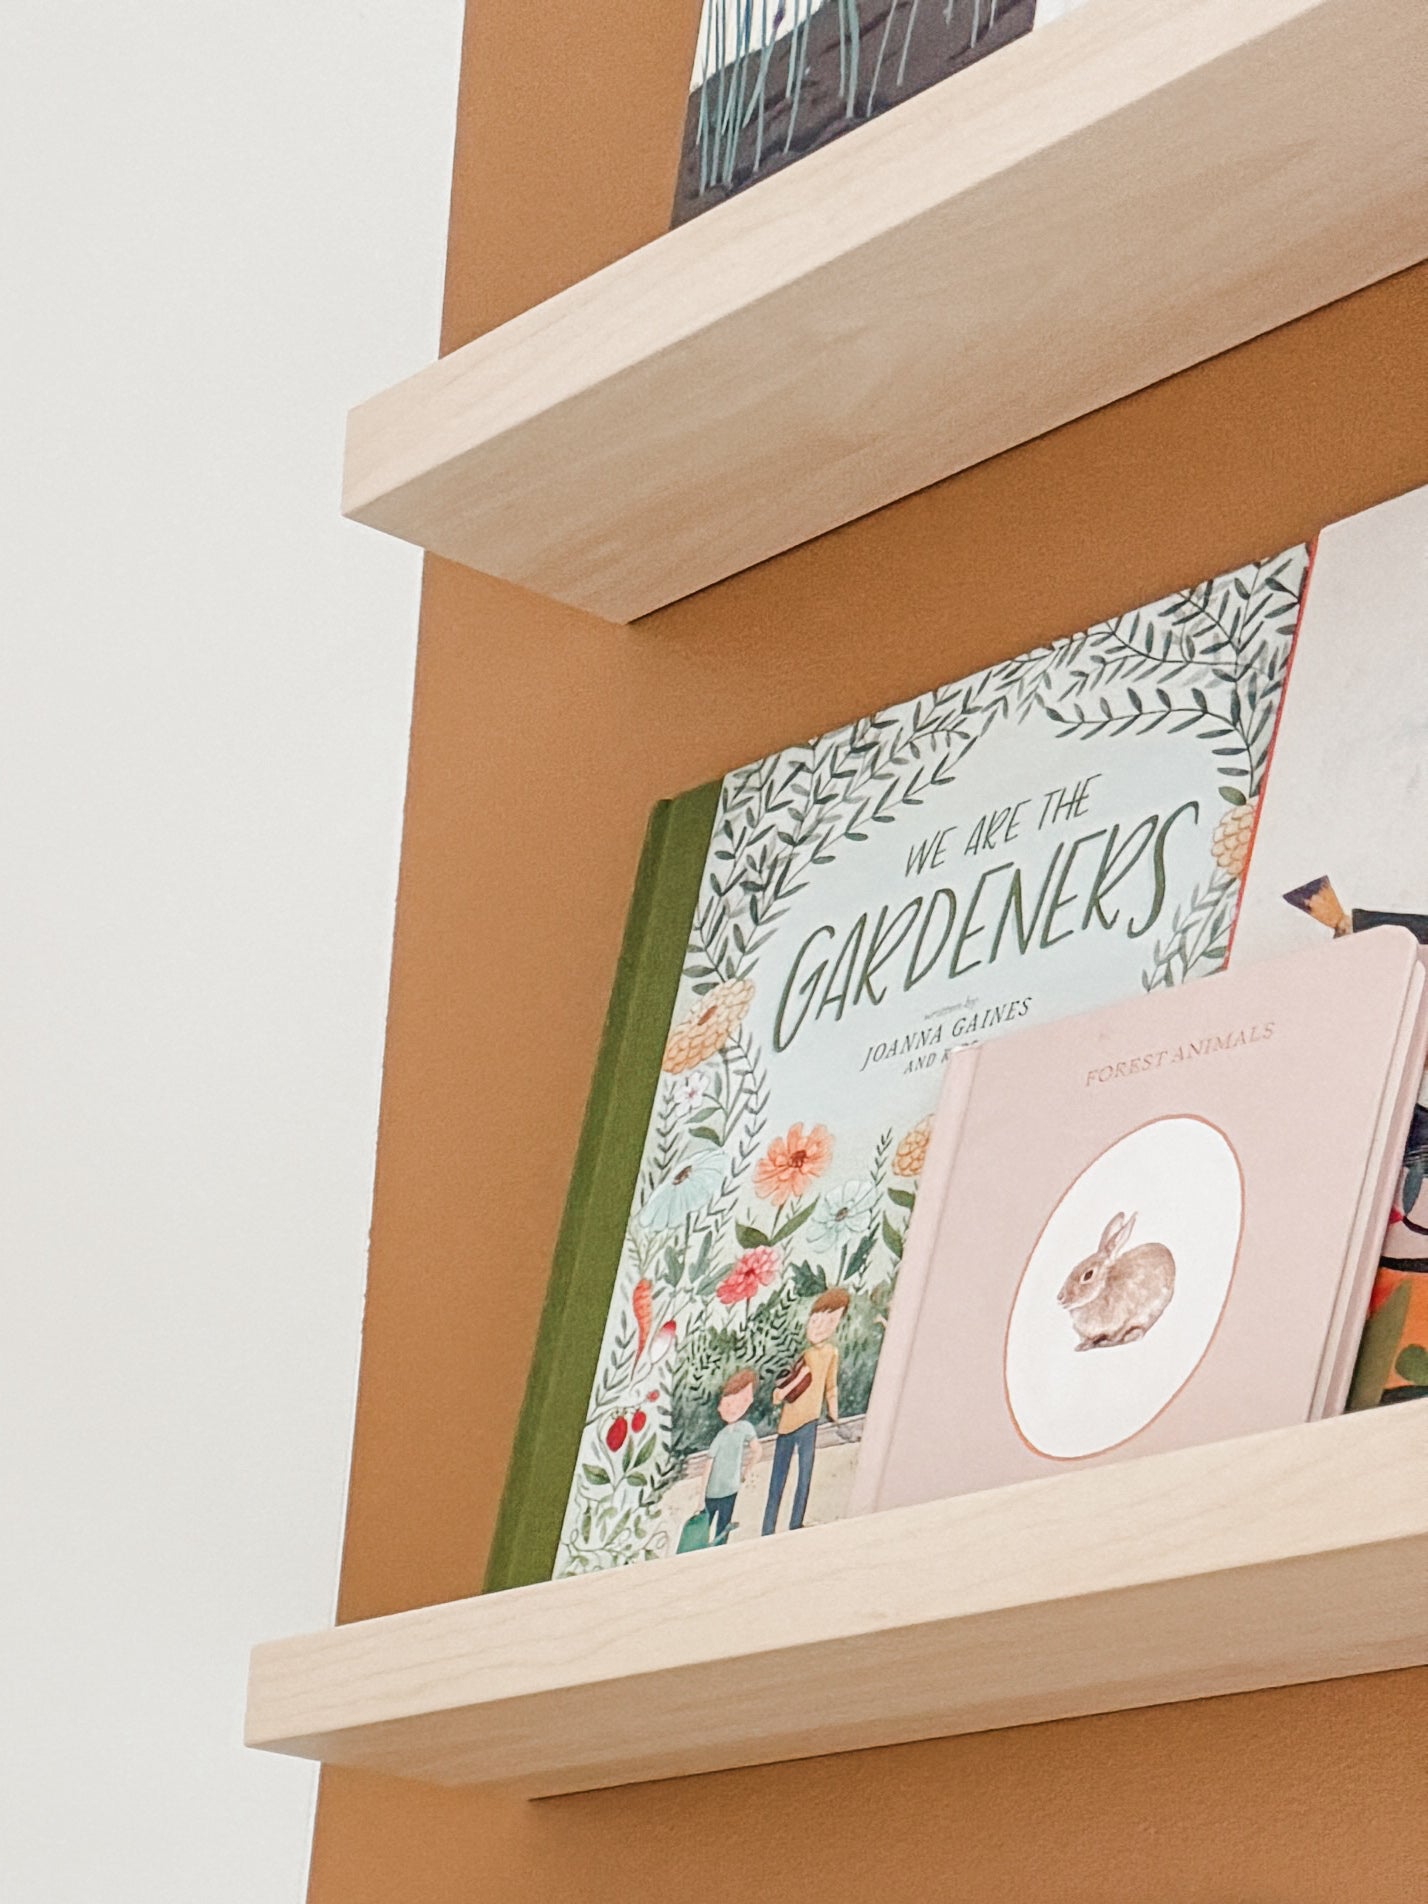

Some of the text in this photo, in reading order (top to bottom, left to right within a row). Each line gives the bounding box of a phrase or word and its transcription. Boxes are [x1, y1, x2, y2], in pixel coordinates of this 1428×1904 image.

[905, 773, 1103, 877] WE ARE THE
[773, 801, 1199, 1052] GARDENERS
[860, 1024, 943, 1072] JOANNA
[951, 997, 1033, 1037] GAINES
[903, 1051, 936, 1075] AND
[1085, 1021, 1276, 1087] FOREST ANIMALS
